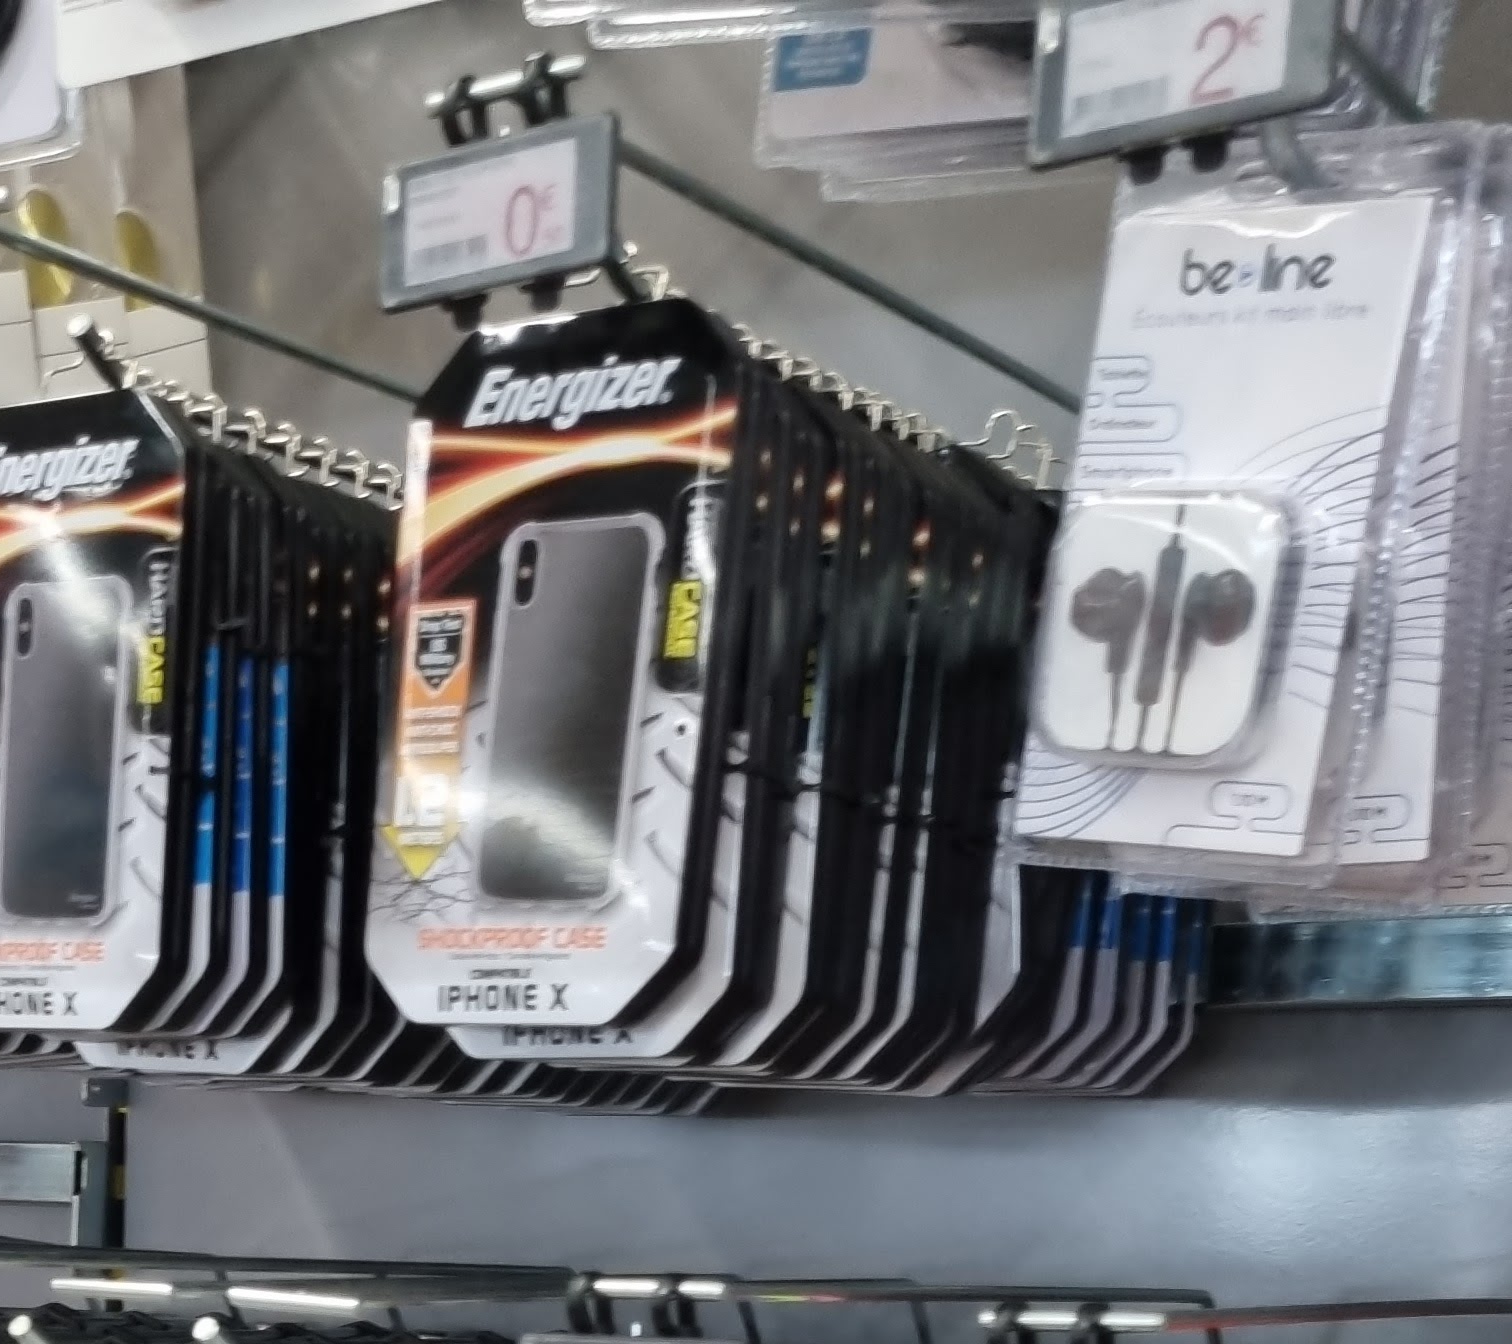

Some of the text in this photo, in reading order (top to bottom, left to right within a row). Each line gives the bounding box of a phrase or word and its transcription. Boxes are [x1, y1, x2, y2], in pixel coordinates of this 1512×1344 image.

[466, 356, 681, 430] Energizer
[437, 983, 570, 1012] IPHONE X
